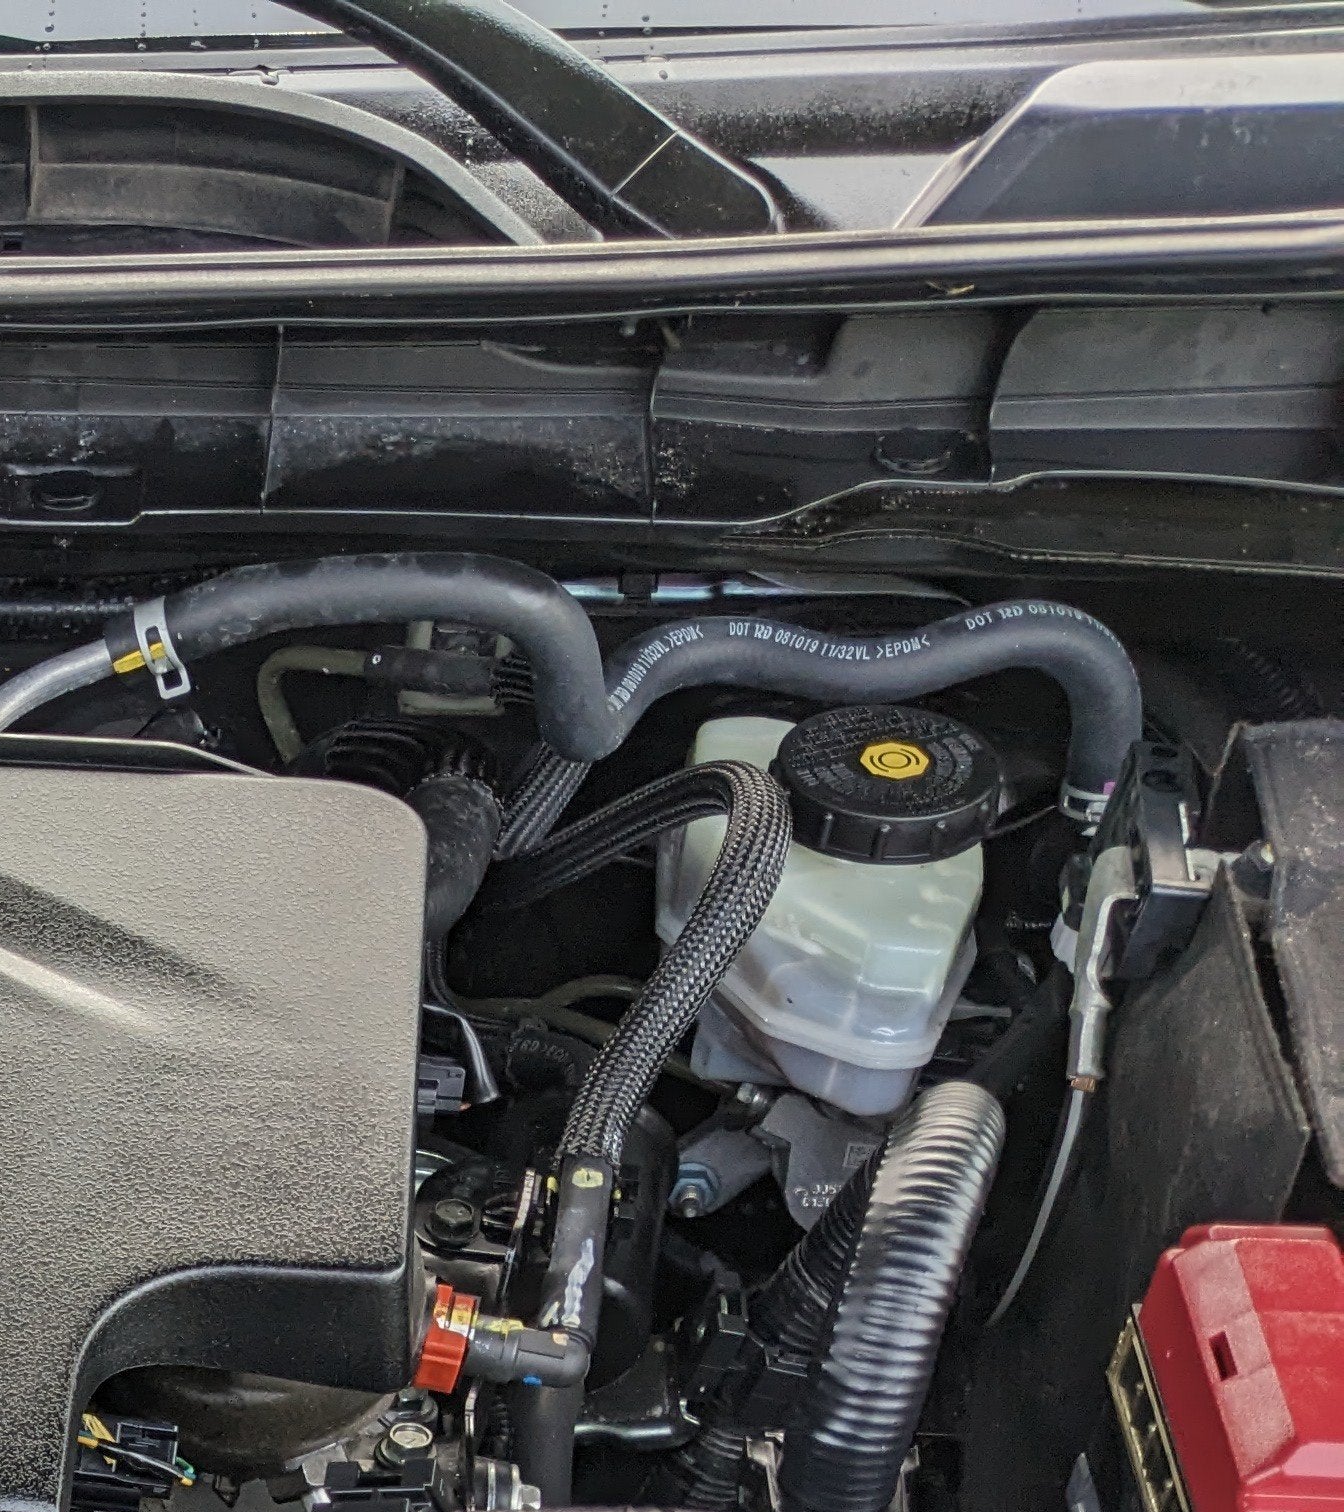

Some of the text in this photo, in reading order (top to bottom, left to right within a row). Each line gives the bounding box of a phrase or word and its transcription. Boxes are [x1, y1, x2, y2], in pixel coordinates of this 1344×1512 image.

[965, 611, 993, 630] DOT
[728, 621, 750, 636] DOT
[774, 629, 819, 654] 081019
